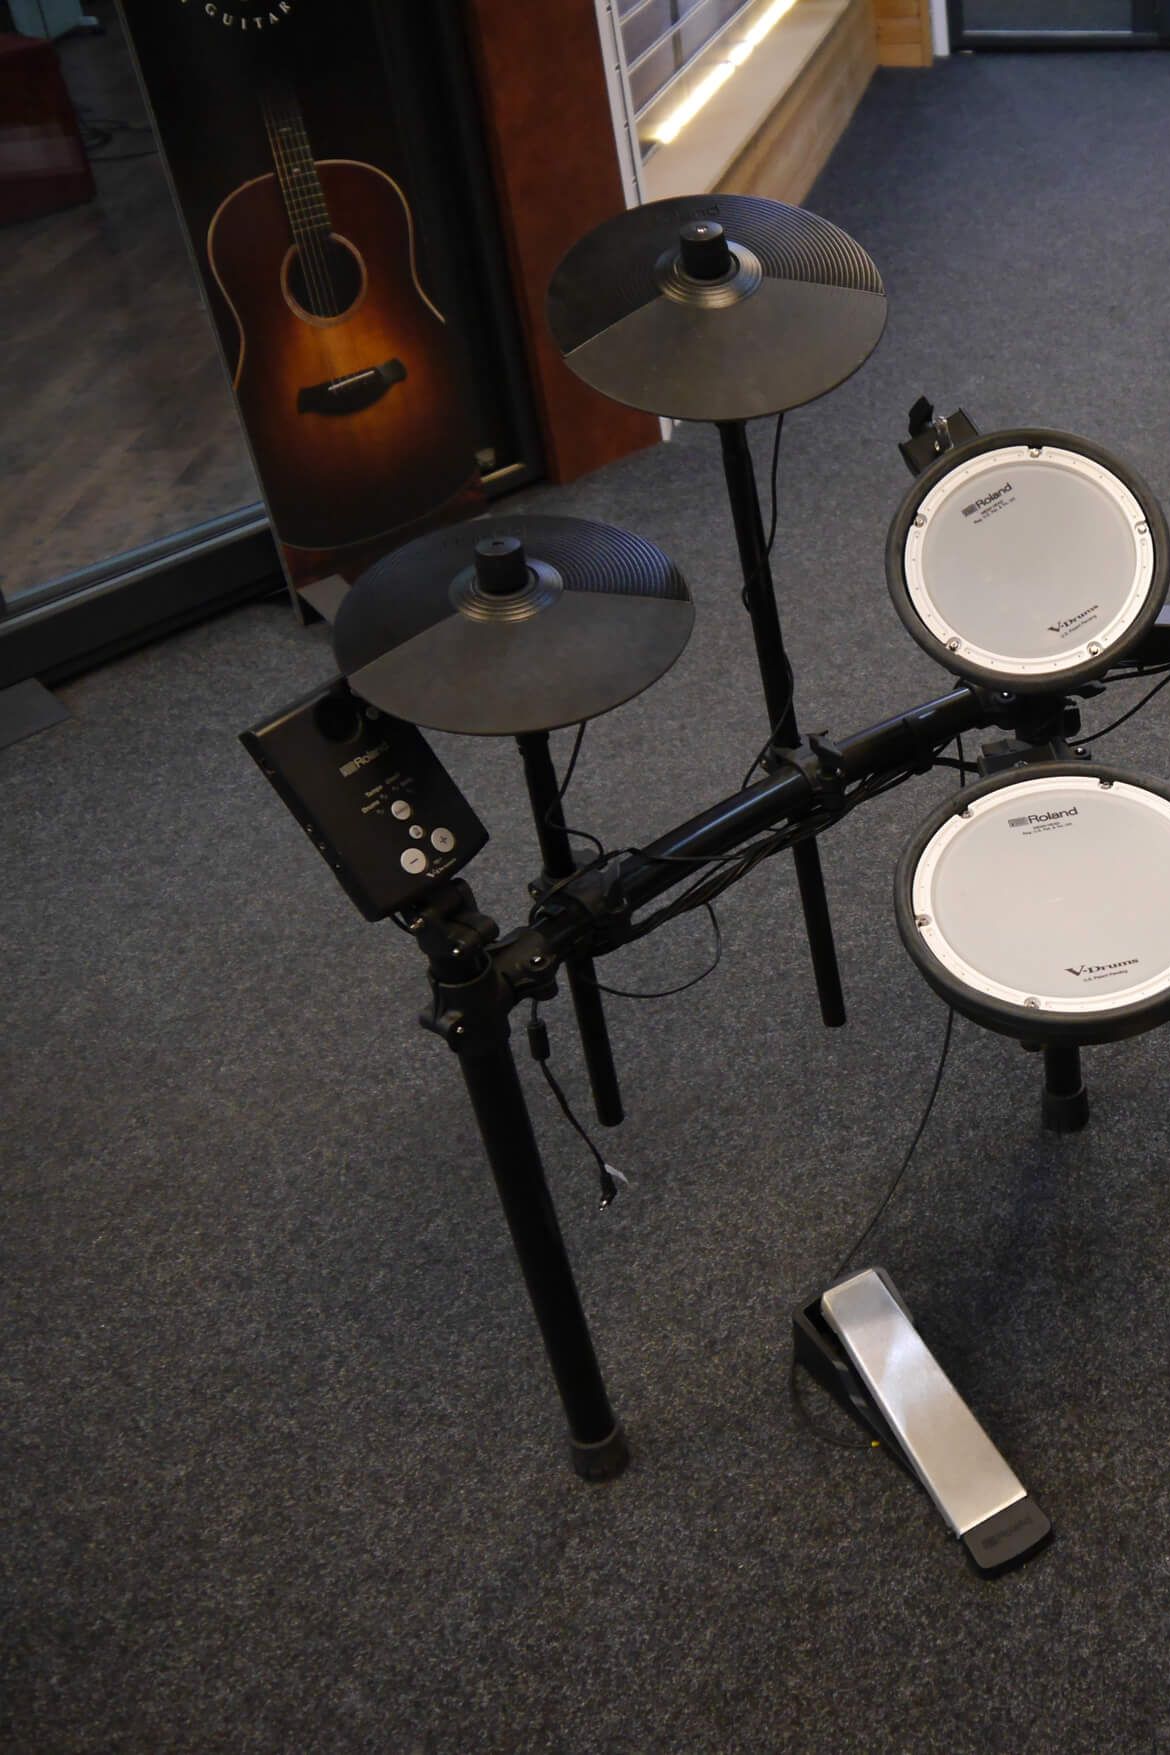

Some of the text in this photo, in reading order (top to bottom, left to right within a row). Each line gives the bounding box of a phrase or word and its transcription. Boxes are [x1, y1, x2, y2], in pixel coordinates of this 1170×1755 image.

[975, 482, 1013, 509] Roland
[1047, 604, 1099, 632] V-Drums
[1027, 806, 1079, 824] Roland
[1064, 958, 1139, 976] V-Drums
